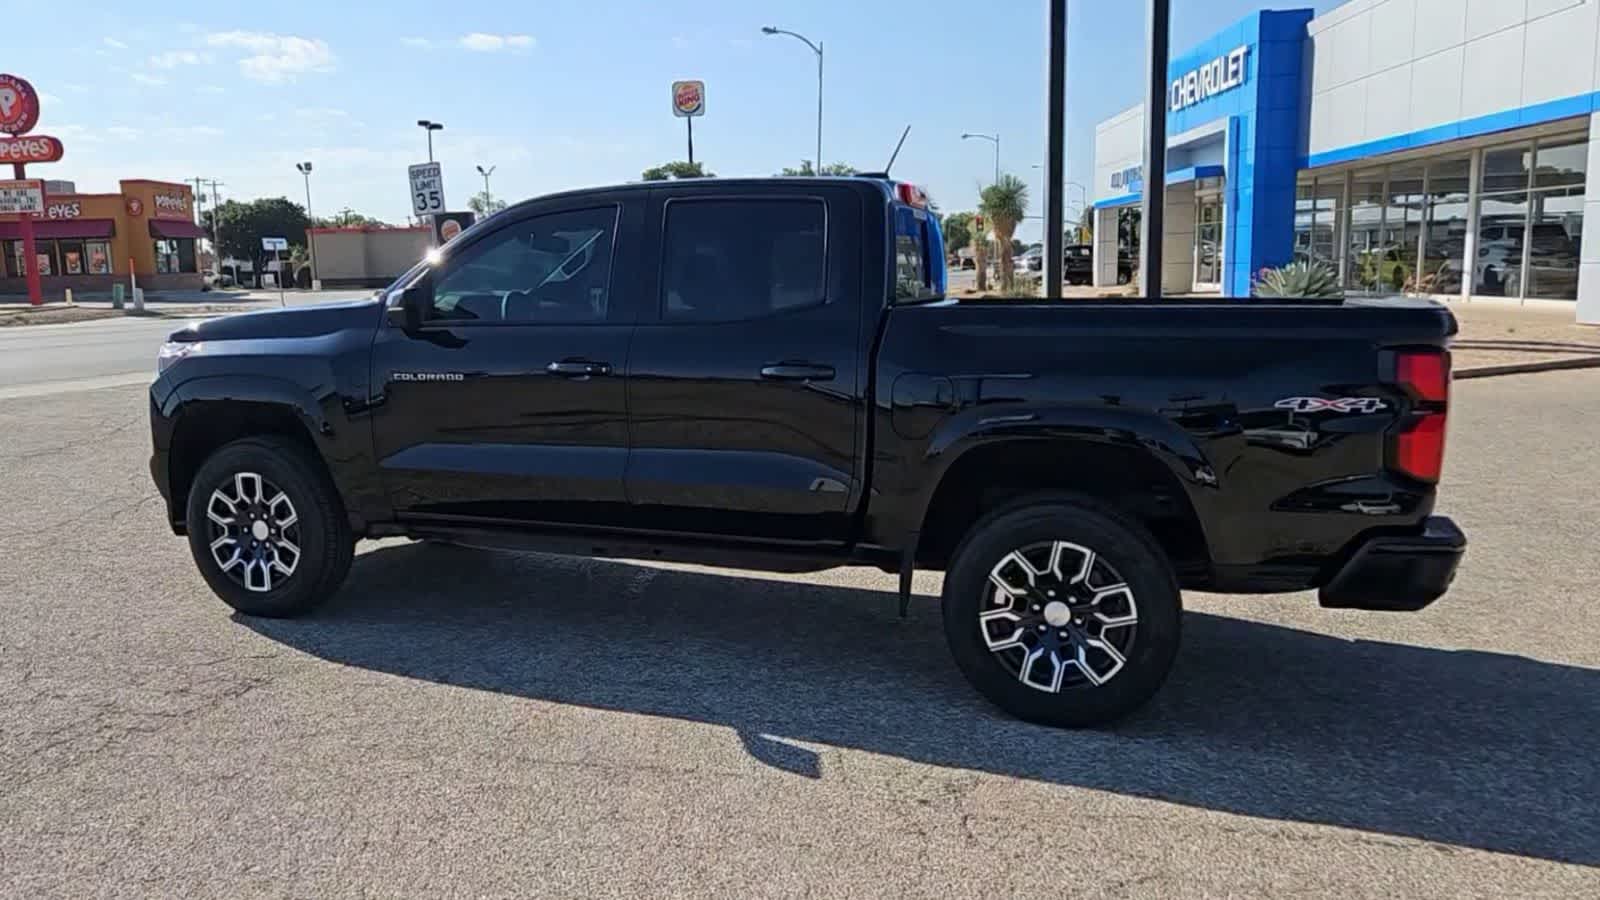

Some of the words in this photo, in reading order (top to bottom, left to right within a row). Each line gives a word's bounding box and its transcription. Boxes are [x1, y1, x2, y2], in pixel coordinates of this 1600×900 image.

[1171, 44, 1247, 111] CHEVROLET
[679, 94, 700, 106] KING
[411, 168, 440, 180] SPEED
[416, 179, 436, 191] LIMIT
[416, 191, 441, 211] 35
[392, 373, 465, 381] COLORADO
